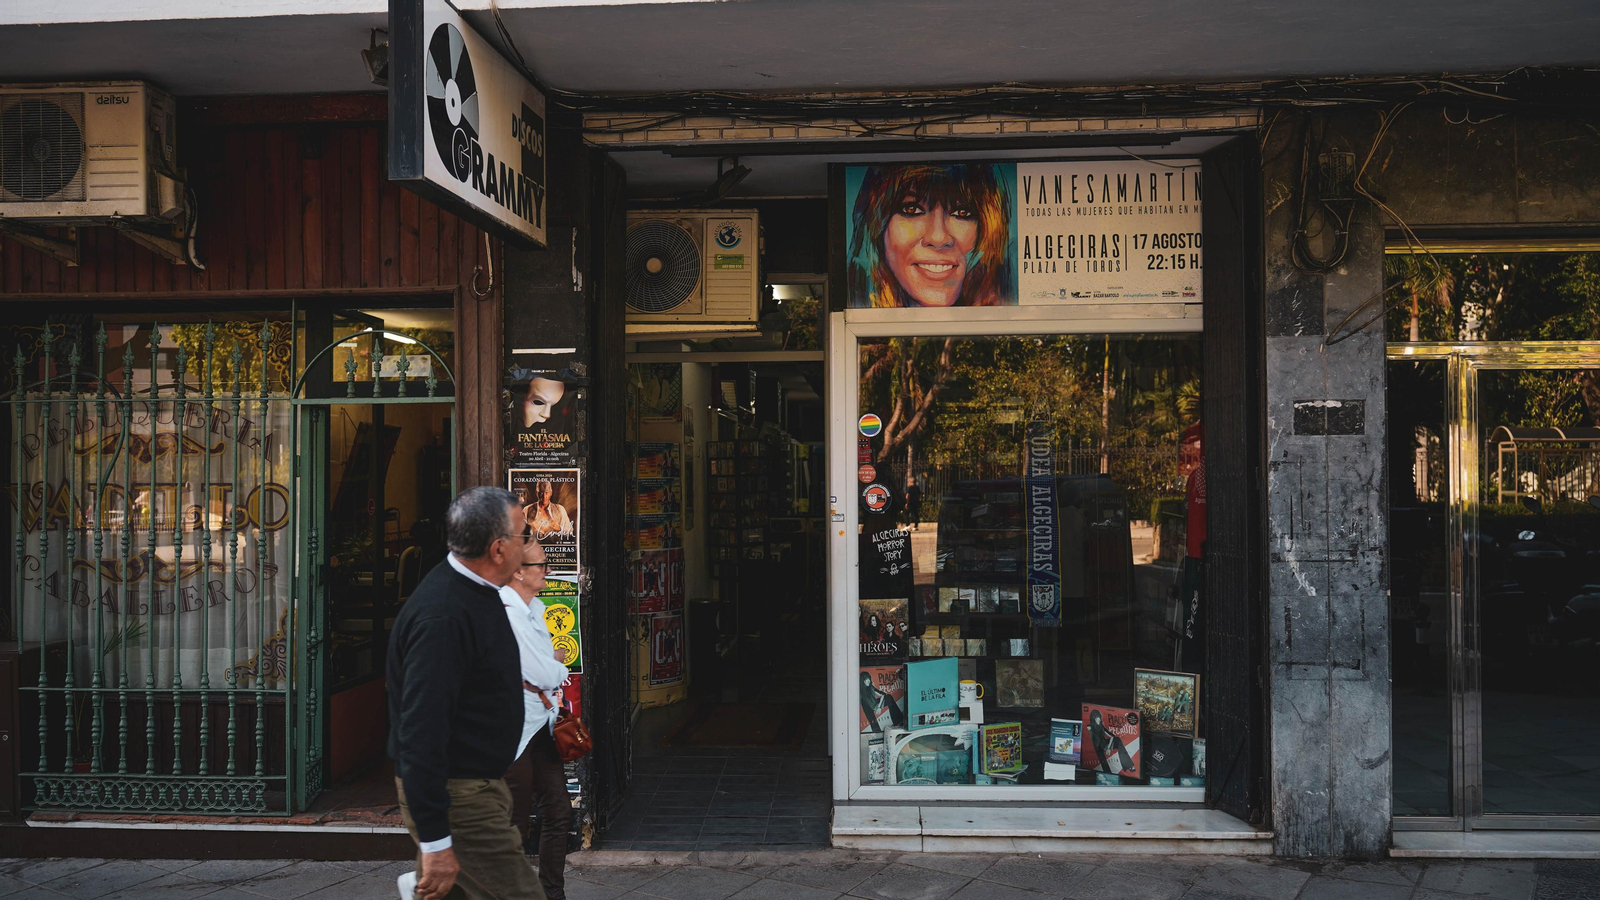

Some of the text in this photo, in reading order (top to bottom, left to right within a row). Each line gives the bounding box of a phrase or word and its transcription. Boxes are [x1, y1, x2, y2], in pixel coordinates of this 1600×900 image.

[511, 112, 544, 158] DISCOS
[451, 127, 546, 230] GRAMMY
[1025, 207, 1052, 217] TODAS
[1056, 207, 1072, 217] LAS
[1076, 206, 1114, 216] MUJERES
[1118, 205, 1133, 215] QUE
[1138, 205, 1174, 215] HABITAN
[1178, 204, 1189, 214] EN
[713, 220, 743, 238] MUNDOCLIMA
[1023, 233, 1120, 260] ALGECIRAS
[1132, 232, 1202, 250] 17 AGOSTO
[1023, 260, 1121, 274] PLAZA DE TOROS
[1147, 253, 1202, 270] 22:15 H.
[518, 433, 571, 443] FANTASMA
[872, 528, 909, 544] ALGECIRAS
[1031, 485, 1053, 571] ALGECIRAS
[883, 549, 903, 562] STORY
[16, 554, 279, 616] CABALLEROS
[859, 641, 898, 654] HÉROES
[927, 687, 946, 695] ÚLTIMO
